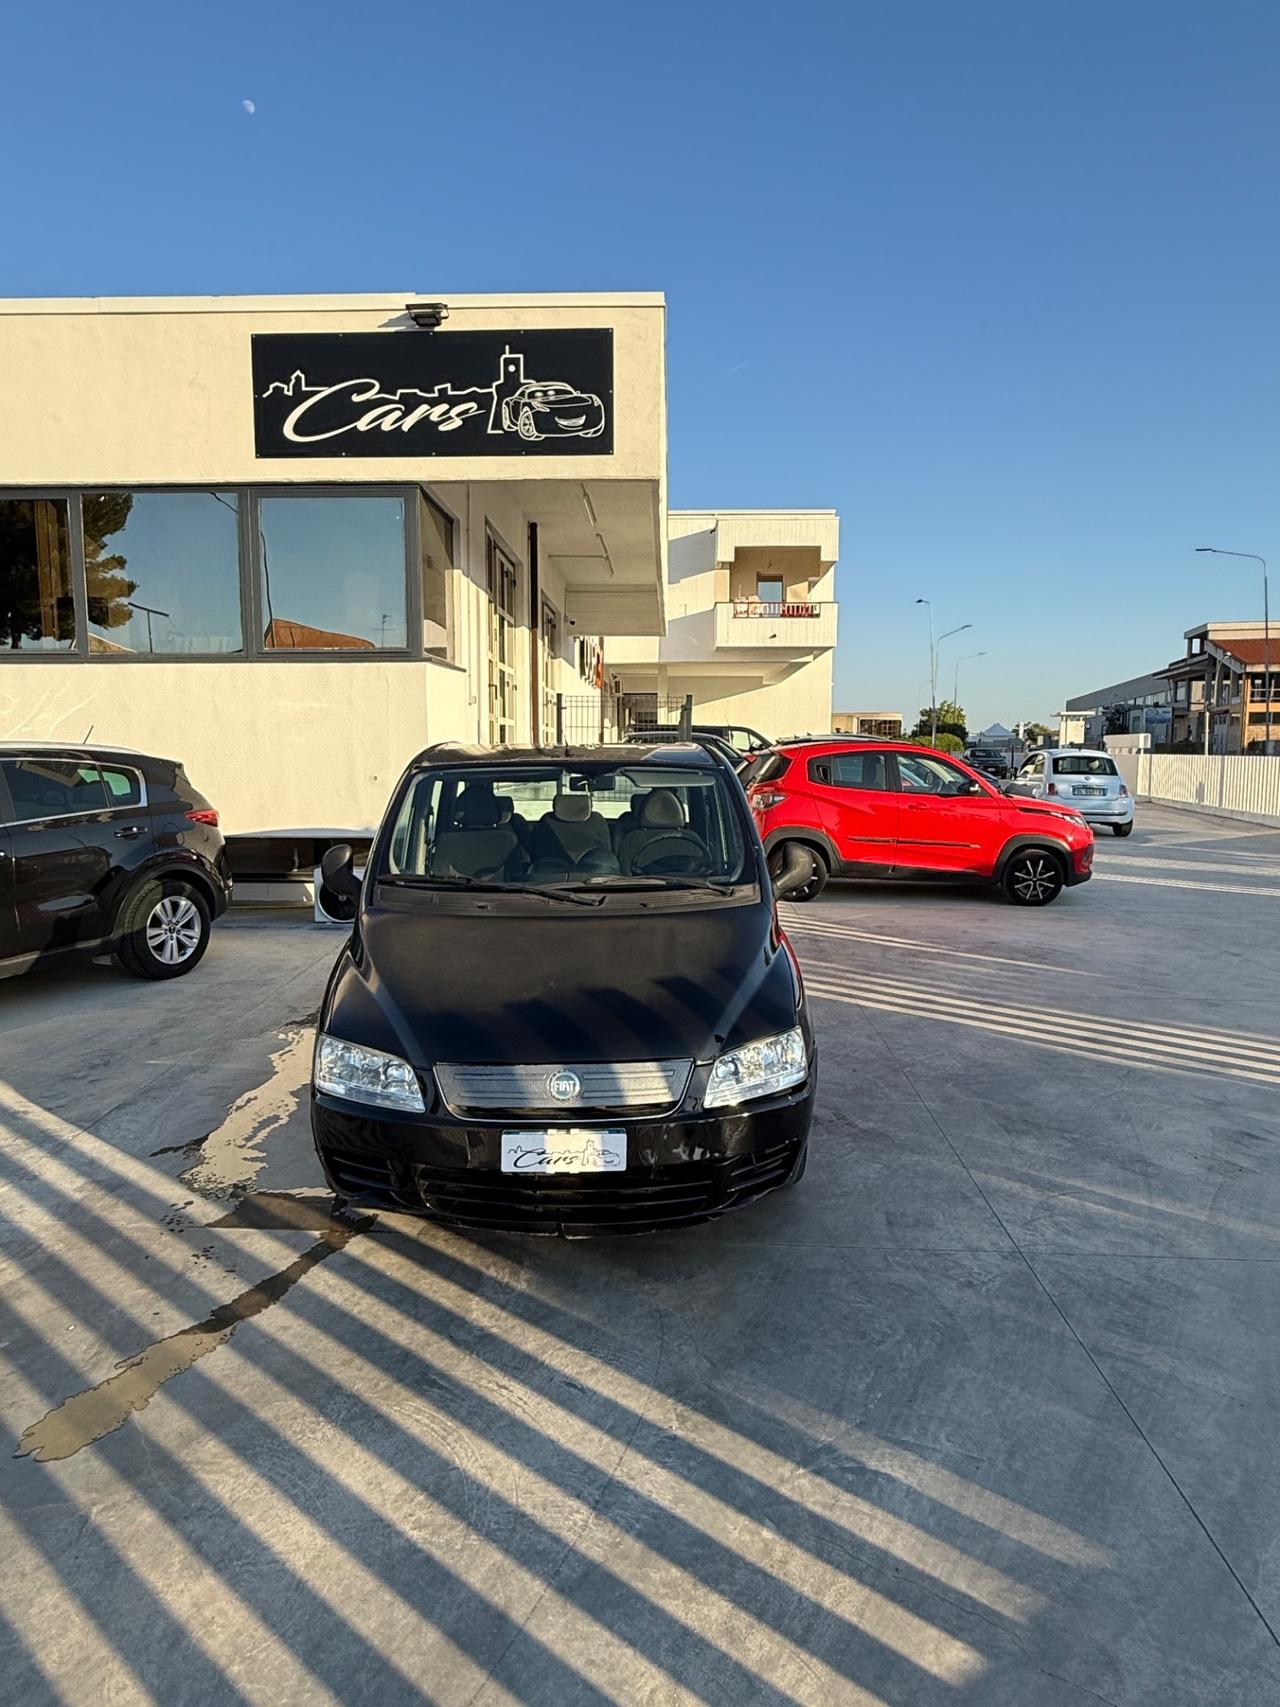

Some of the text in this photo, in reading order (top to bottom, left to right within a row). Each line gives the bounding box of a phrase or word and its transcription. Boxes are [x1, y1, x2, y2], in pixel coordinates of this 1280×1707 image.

[282, 378, 487, 442] Cars
[554, 1080, 575, 1092] FIAT
[513, 1147, 579, 1169] Cars
